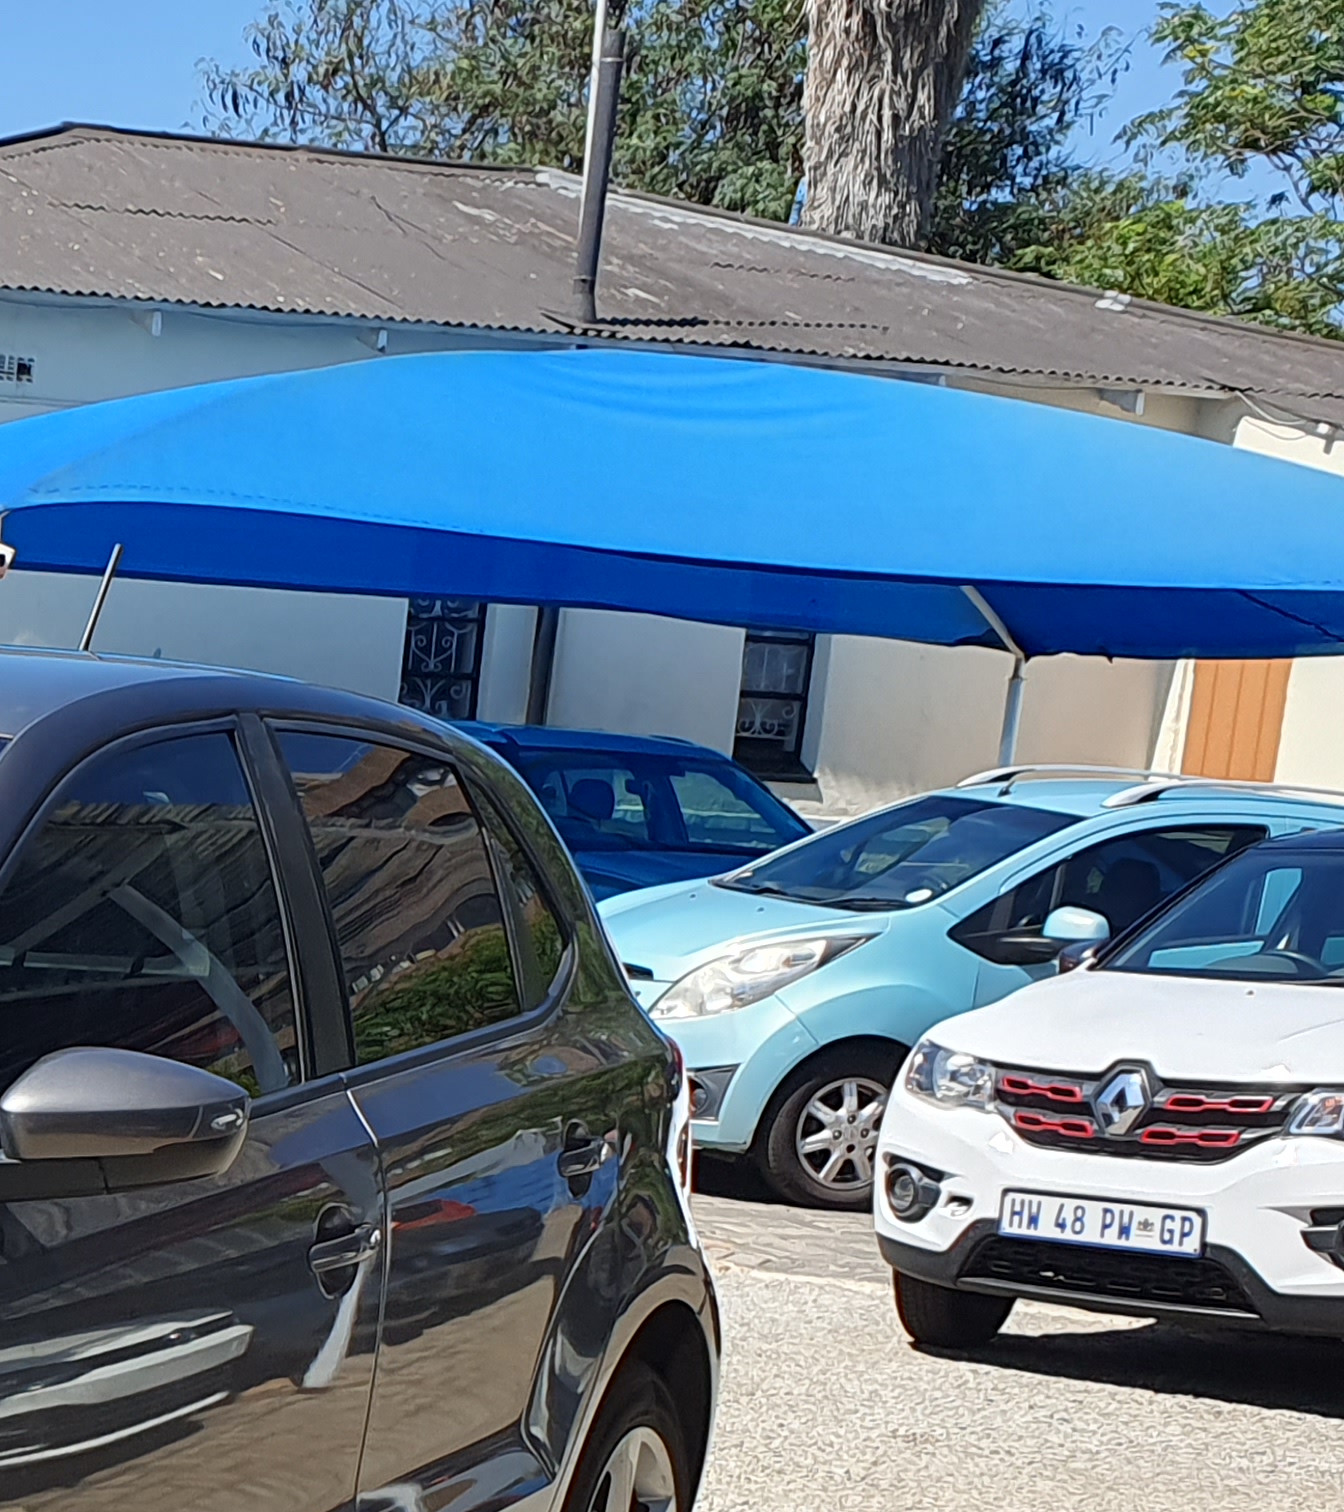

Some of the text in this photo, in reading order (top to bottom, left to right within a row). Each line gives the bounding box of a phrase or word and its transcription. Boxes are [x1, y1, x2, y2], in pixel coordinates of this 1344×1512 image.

[1009, 1198, 1194, 1247] HW 48 PW GP
